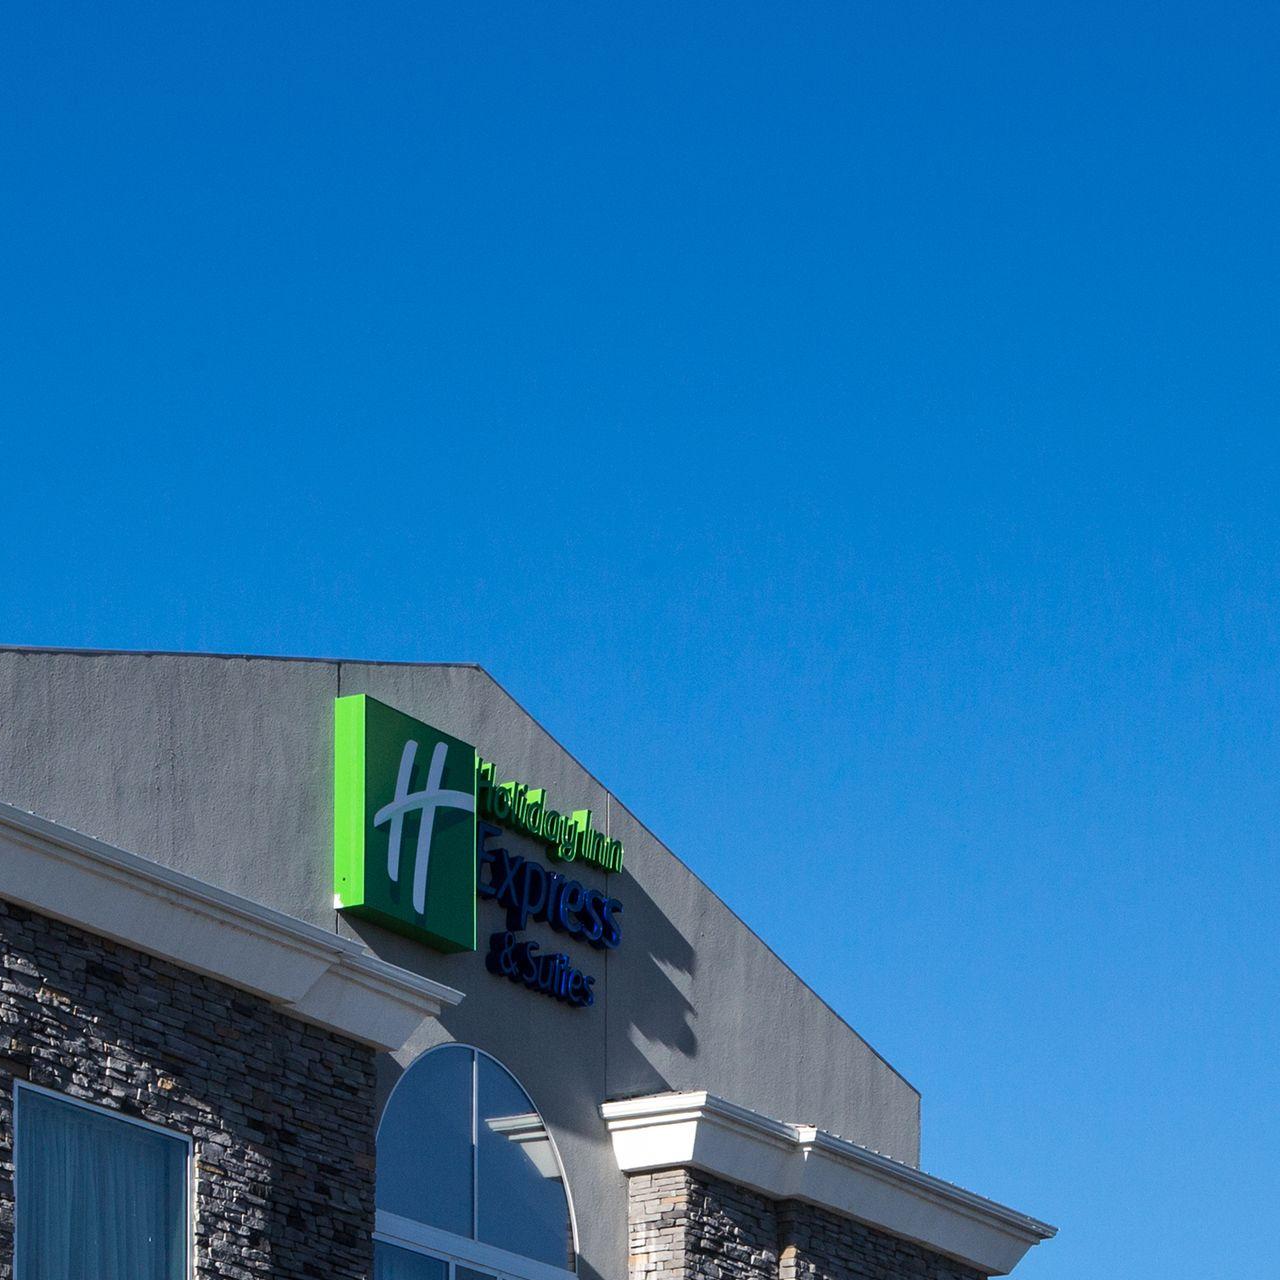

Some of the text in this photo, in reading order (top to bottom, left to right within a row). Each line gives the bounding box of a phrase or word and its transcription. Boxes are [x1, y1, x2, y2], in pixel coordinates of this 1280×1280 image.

[477, 757, 624, 873] Holiday Inn
[477, 821, 624, 949] Express
[492, 930, 596, 1008] & Suites
